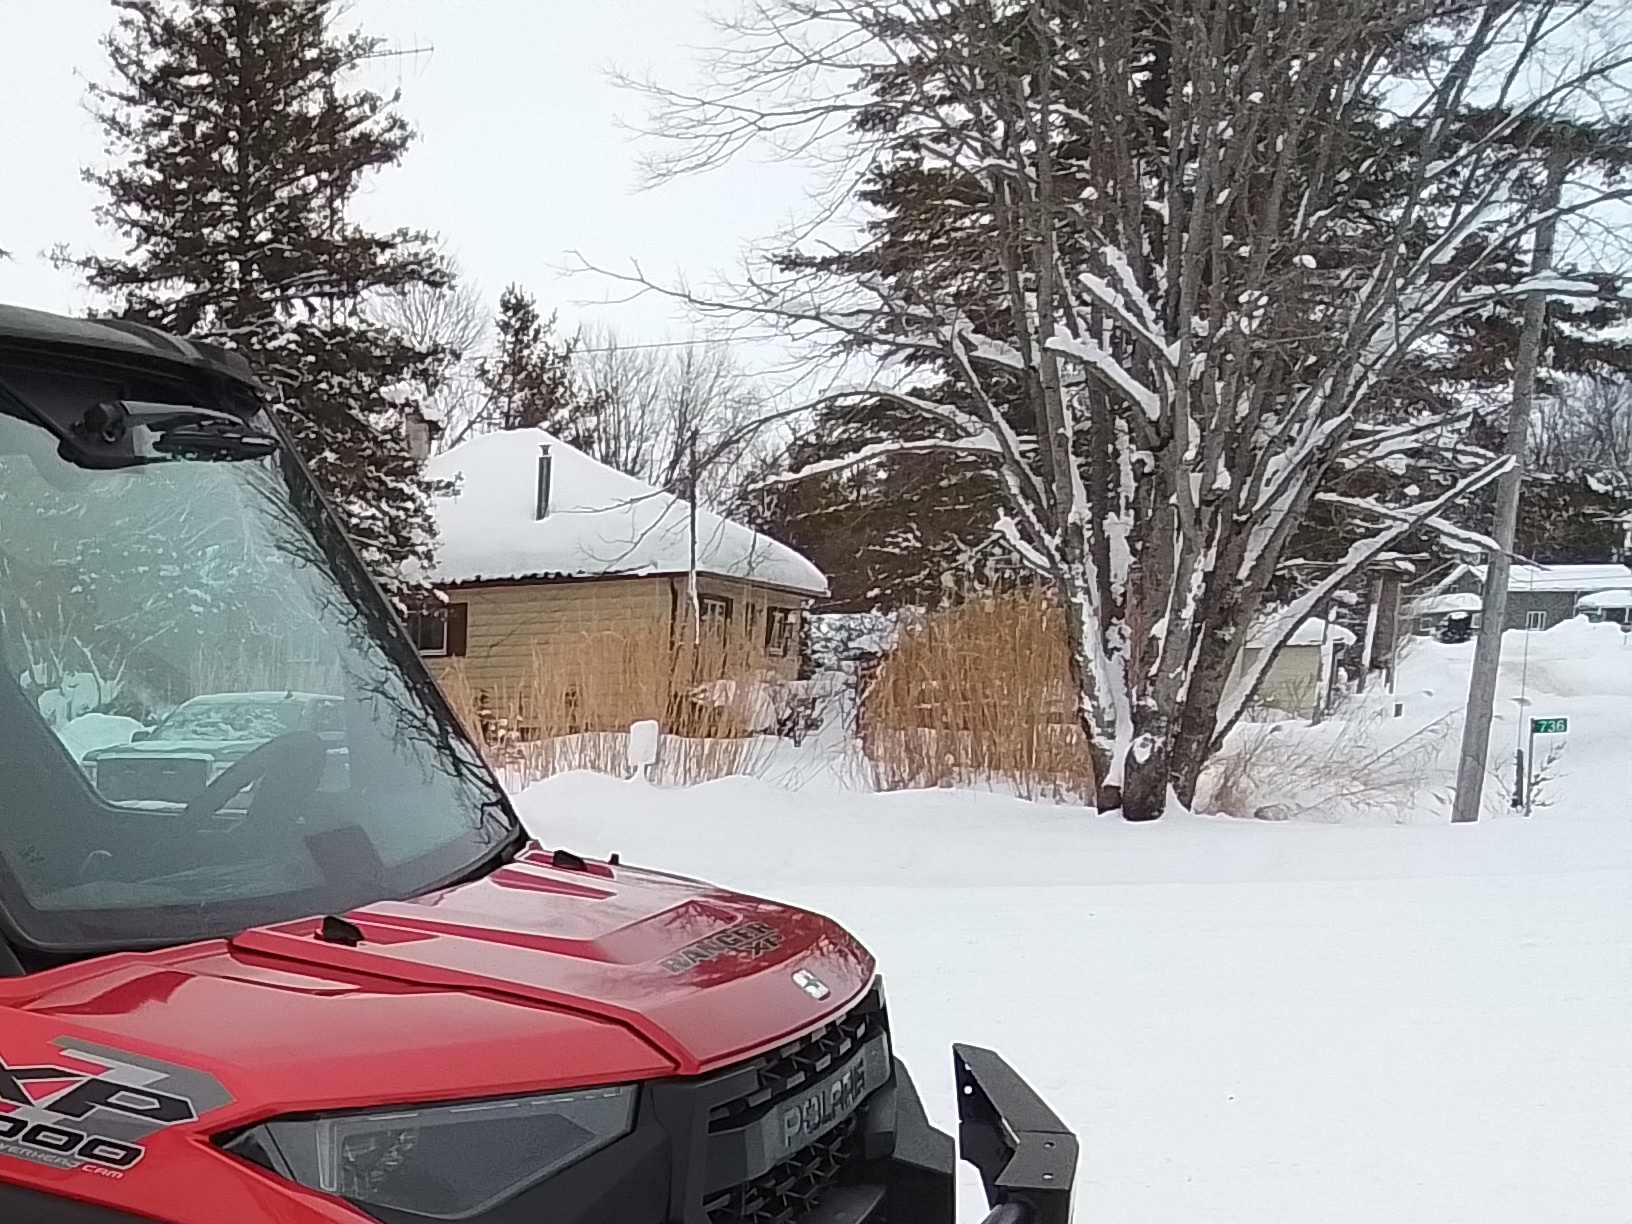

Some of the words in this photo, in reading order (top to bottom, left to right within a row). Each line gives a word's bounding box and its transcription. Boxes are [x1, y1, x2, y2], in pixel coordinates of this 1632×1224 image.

[1538, 719, 1565, 732] 736
[656, 921, 778, 975] RANGER
[81, 1164, 124, 1180] CAM
